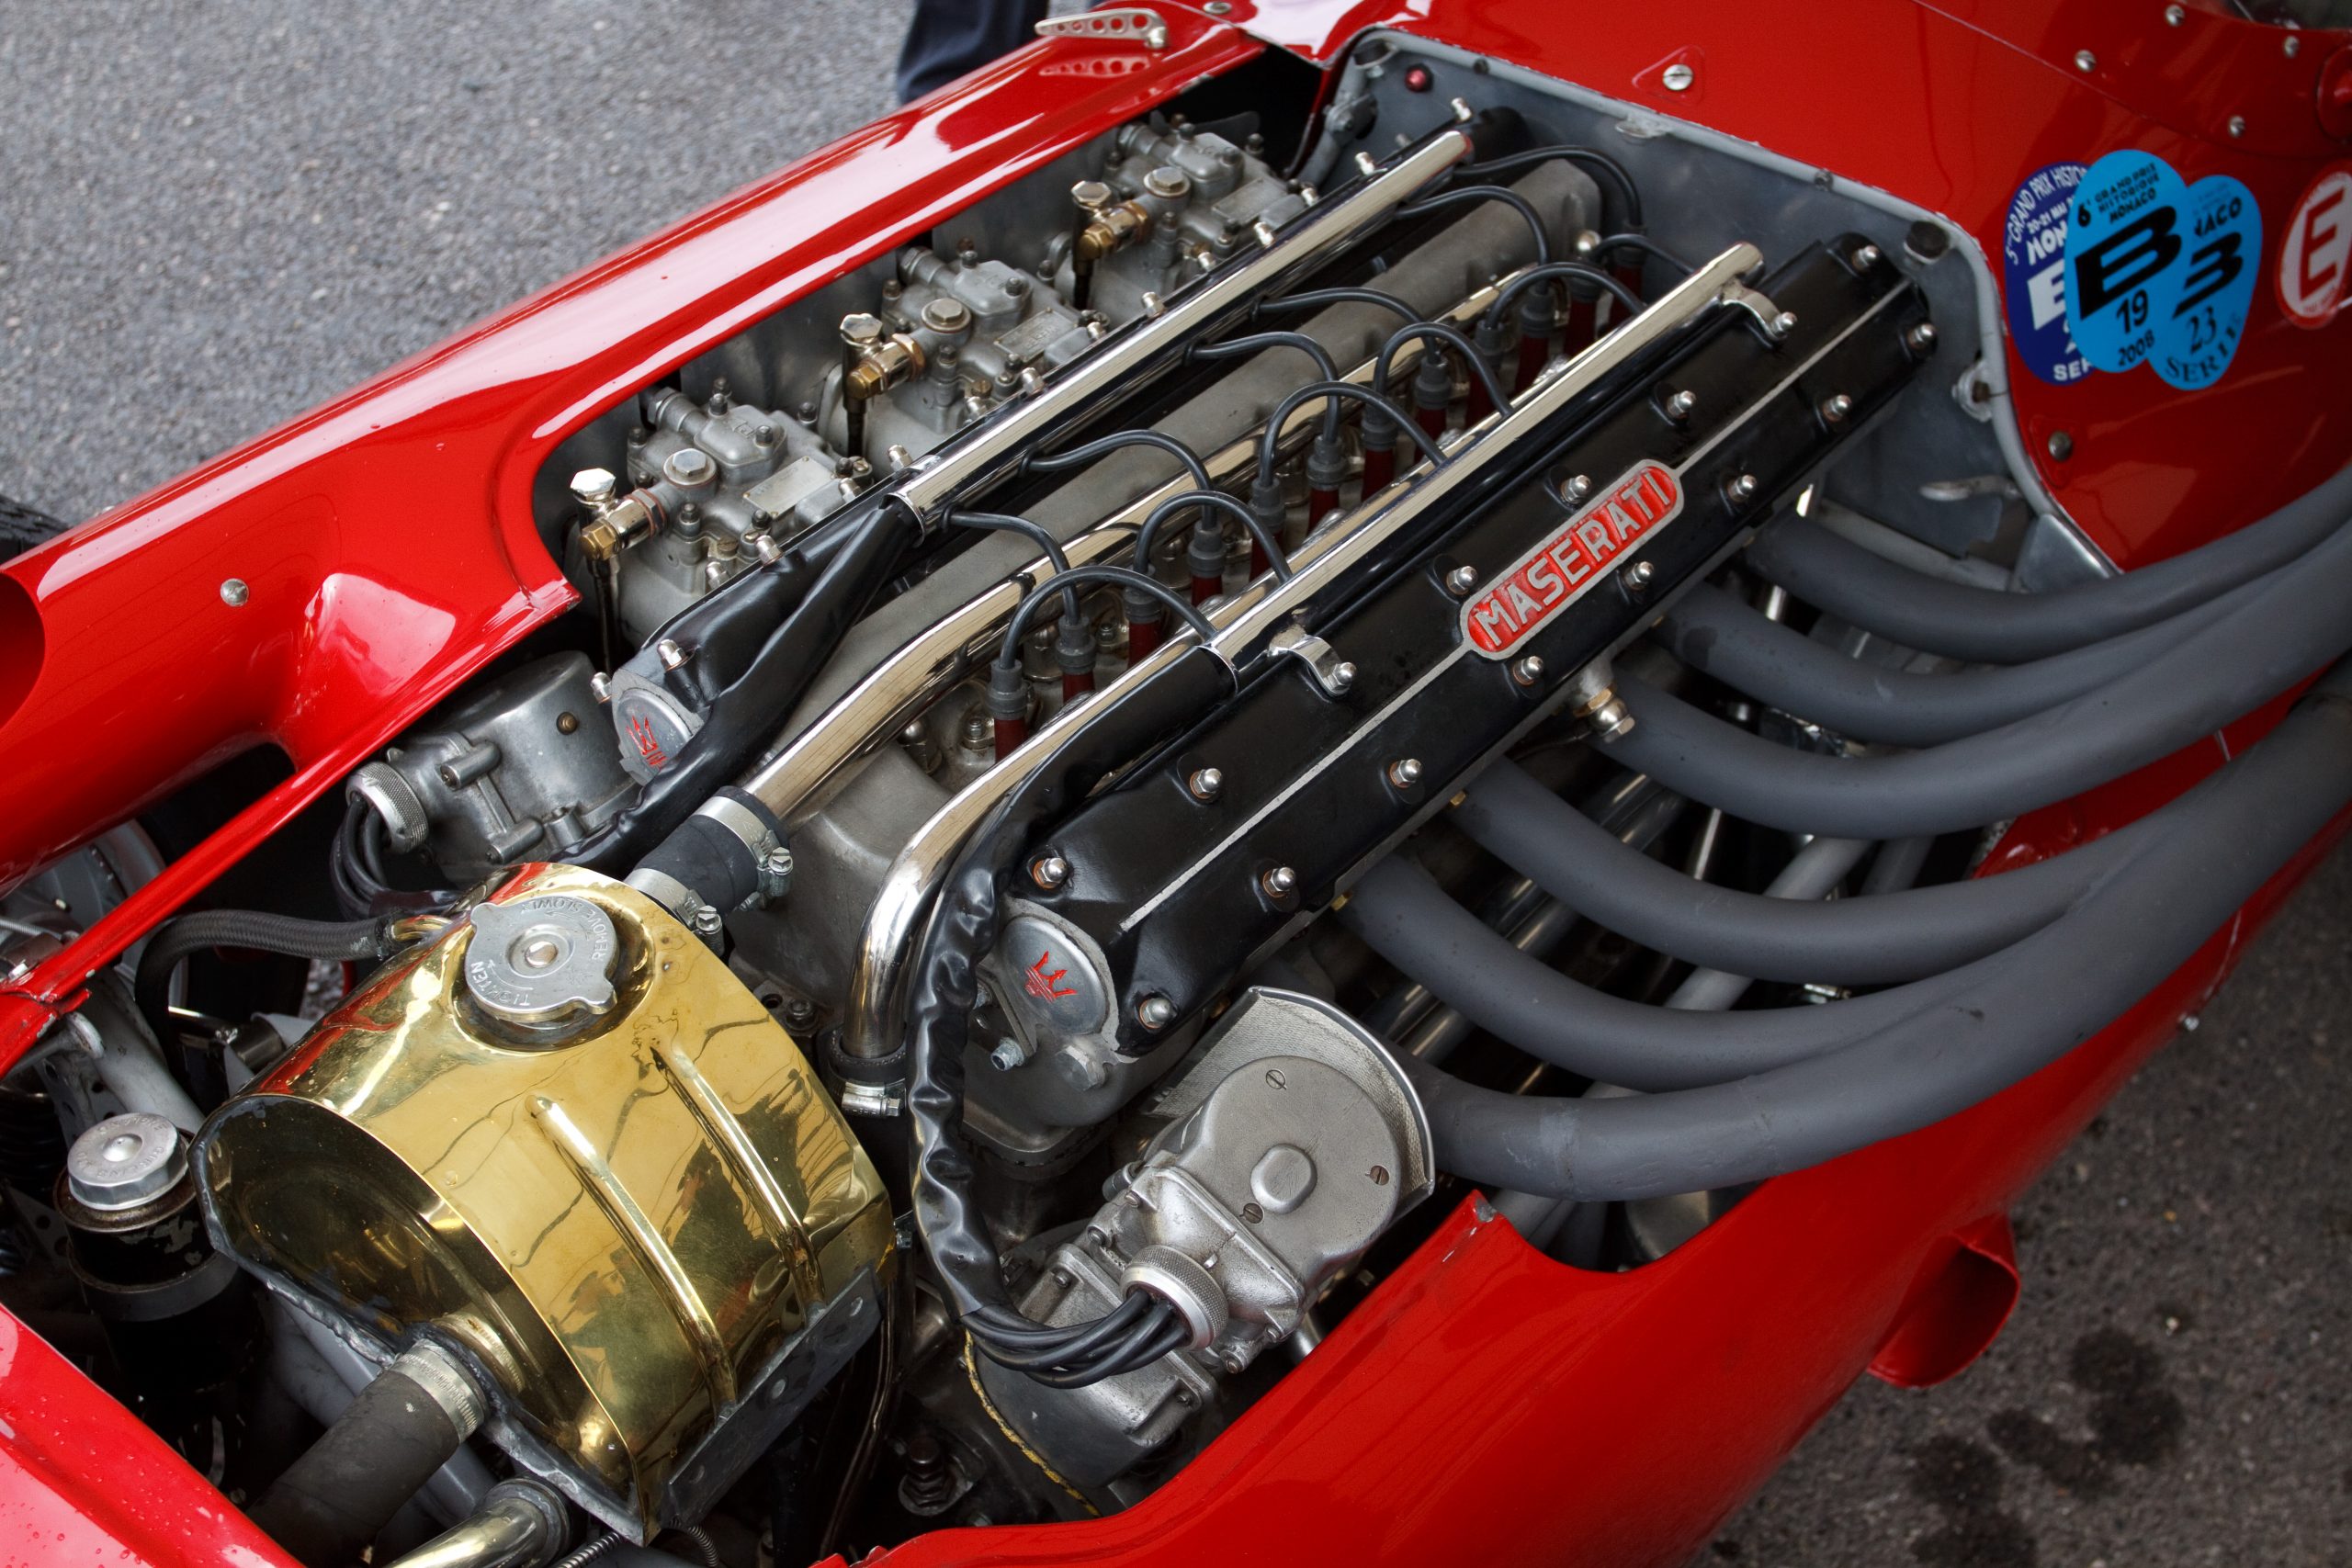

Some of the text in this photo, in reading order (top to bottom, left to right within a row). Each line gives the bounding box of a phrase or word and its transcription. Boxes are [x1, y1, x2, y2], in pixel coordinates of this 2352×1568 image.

[2007, 189, 2036, 243] GRAND
[2029, 172, 2055, 200] PRIX
[2095, 176, 2132, 203] GRAND
[2109, 187, 2156, 224] MONACO
[2075, 206, 2182, 320] B
[2300, 186, 2346, 302] E
[2116, 289, 2148, 333] 19
[2188, 305, 2217, 355] 23
[2119, 329, 2154, 366] 2008
[1474, 472, 1670, 647] MASERATI
[582, 910, 608, 961] REMOVE
[471, 961, 530, 1006] TIGHTEN
